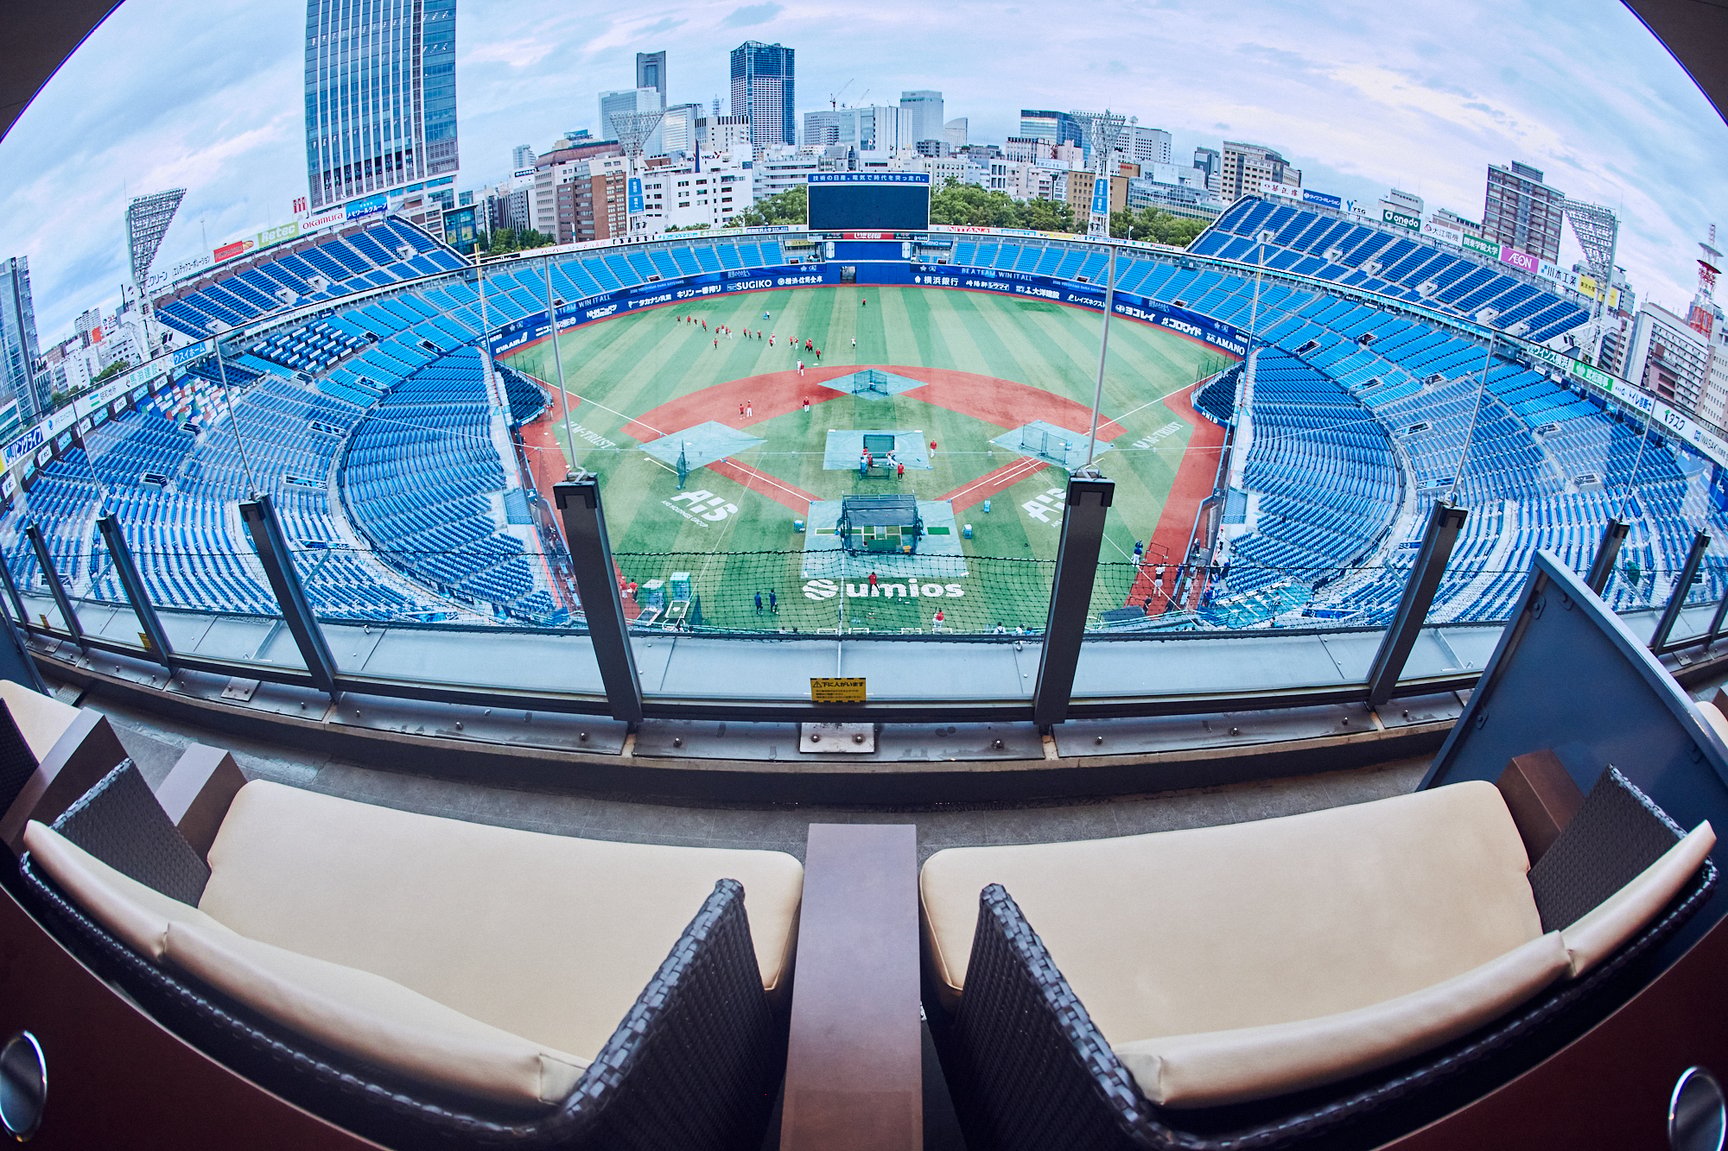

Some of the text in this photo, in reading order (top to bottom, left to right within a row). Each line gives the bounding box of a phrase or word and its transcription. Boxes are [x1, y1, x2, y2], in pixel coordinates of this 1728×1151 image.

[1393, 215, 1419, 228] onedo
[736, 278, 773, 291] SUGIKO
[923, 275, 959, 287] 横浜銀行
[1125, 306, 1156, 322] ヨコレイ
[174, 343, 206, 364] ウスイホーム
[1214, 337, 1246, 356] AMANO
